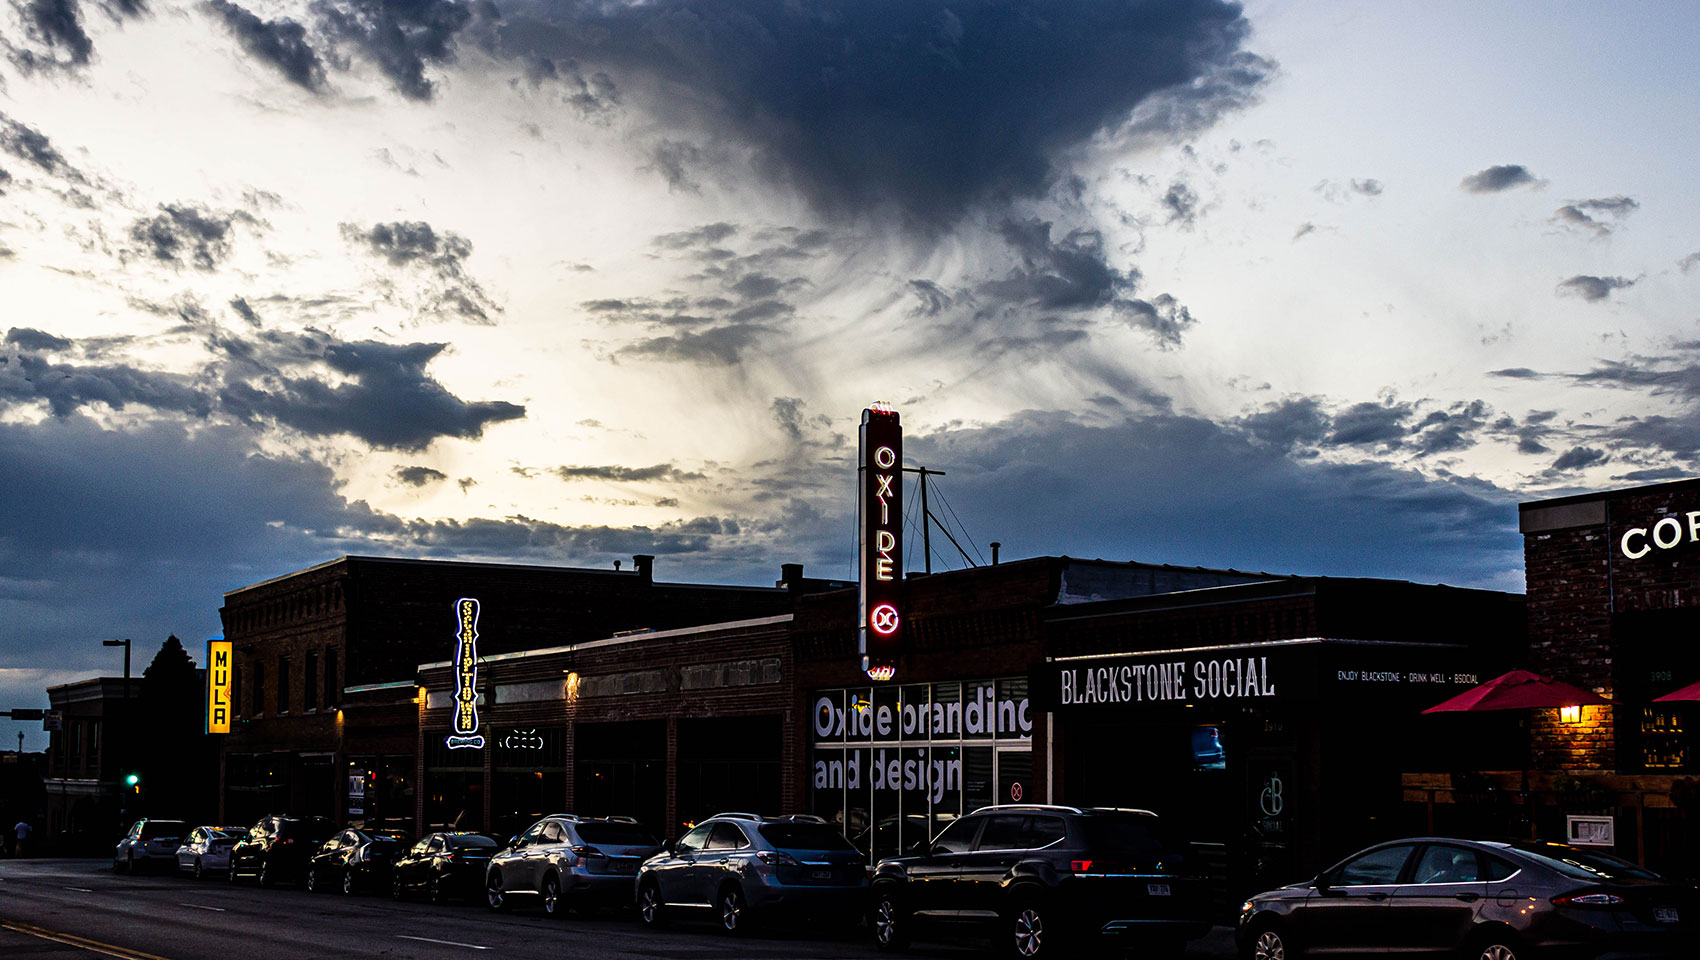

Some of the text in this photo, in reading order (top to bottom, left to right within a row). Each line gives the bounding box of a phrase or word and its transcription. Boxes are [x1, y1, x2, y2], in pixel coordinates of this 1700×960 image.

[874, 446, 896, 582] OXIDE
[214, 651, 227, 724] MULA
[460, 601, 474, 729] SCRIPTOWN
[1061, 657, 1276, 704] BLACKSTONE SOCIAL
[1337, 670, 1479, 685] ENJOY BLACKSTONE DRINK WELL BSOCIAL
[1650, 670, 1672, 682] 3908
[815, 693, 892, 737] Oxide
[815, 748, 961, 805] and design
